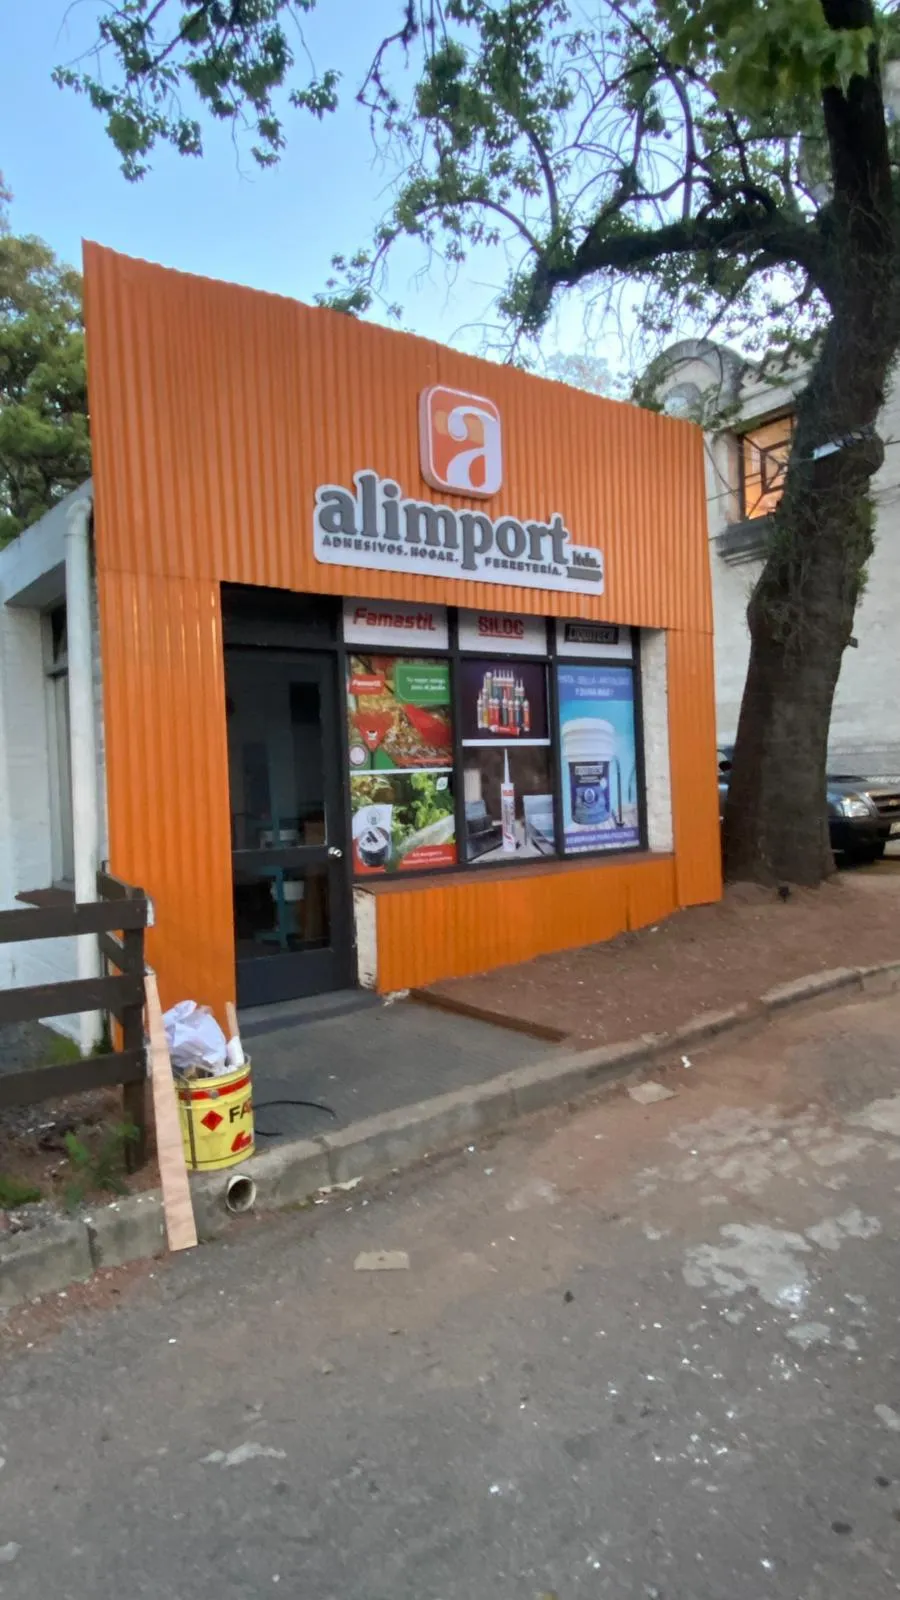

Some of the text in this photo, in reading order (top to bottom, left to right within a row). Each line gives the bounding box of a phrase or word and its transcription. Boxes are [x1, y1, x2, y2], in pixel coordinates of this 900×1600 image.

[318, 474, 569, 571] alimport
[322, 534, 408, 556] ADHESIVOS.
[410, 546, 460, 562] HOGAR.
